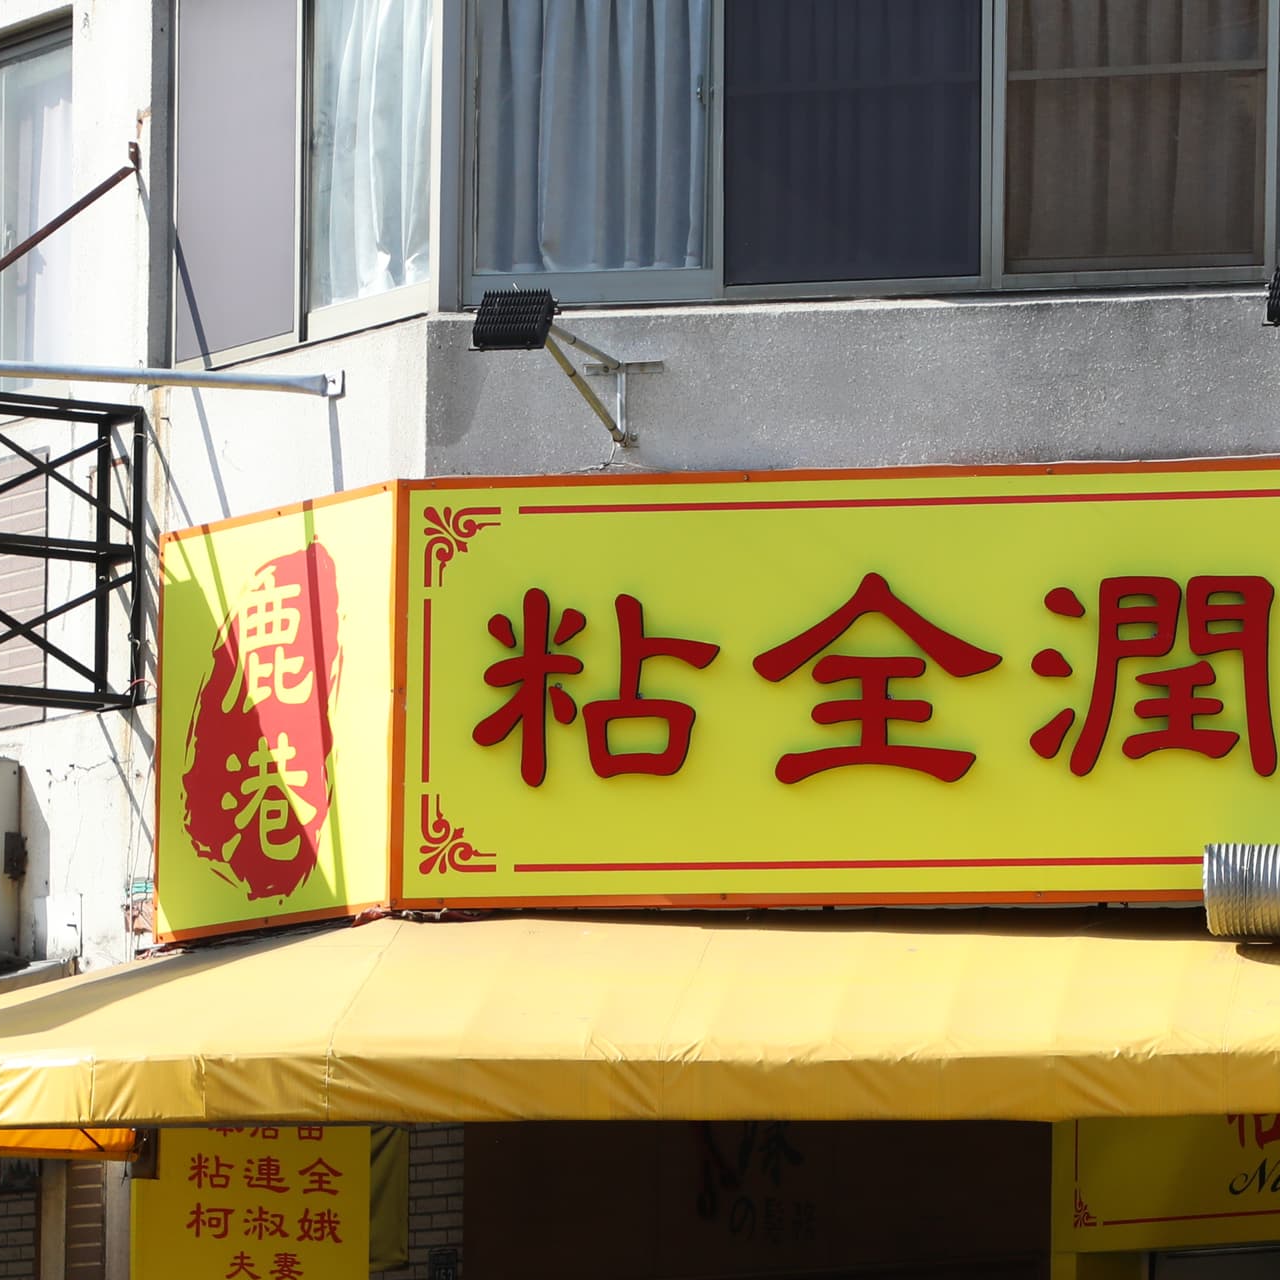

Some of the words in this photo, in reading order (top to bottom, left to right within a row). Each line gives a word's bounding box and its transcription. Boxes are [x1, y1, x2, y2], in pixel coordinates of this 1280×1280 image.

[220, 568, 317, 862] 鹿港
[188, 1152, 344, 1196] 粘連全
[186, 1202, 343, 1243] 柯淑娥
[225, 1251, 304, 1280] 夫妻
